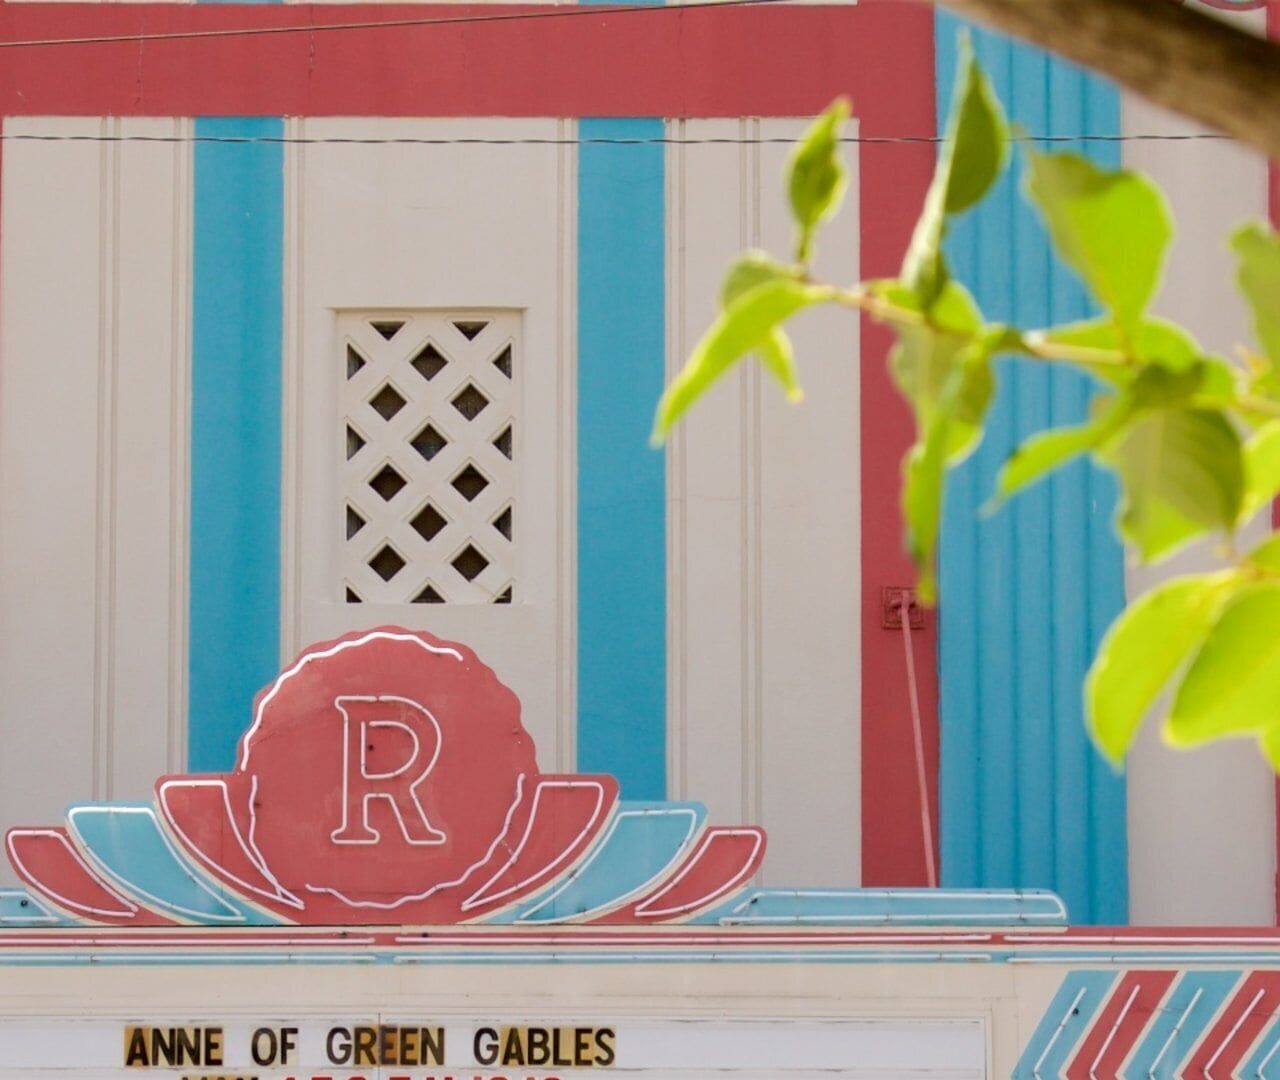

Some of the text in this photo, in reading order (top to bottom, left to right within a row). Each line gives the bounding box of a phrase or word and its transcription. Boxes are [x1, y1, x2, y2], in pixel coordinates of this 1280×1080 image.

[331, 695, 447, 845] R
[125, 1026, 616, 1067] ANNE OF GREEN GABLES
